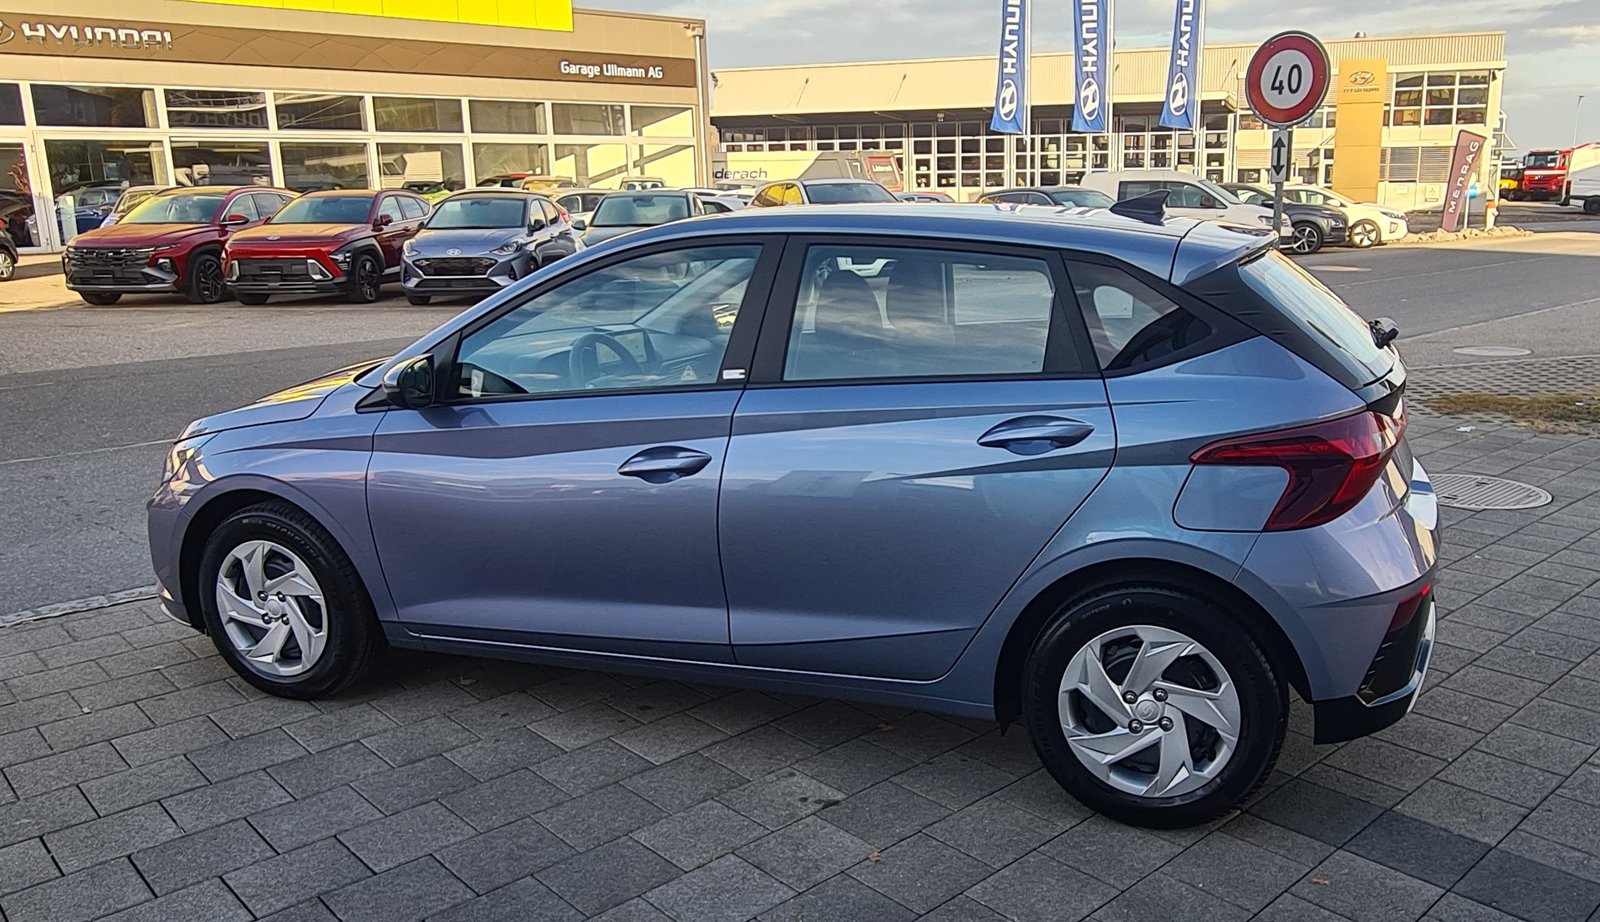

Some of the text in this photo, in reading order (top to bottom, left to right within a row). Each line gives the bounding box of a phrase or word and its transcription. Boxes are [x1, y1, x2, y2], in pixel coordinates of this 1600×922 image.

[21, 22, 173, 50] HYUNDAI
[560, 61, 664, 79] Garage Ullmann AG
[1270, 63, 1303, 95] 40
[712, 167, 768, 179] derach
